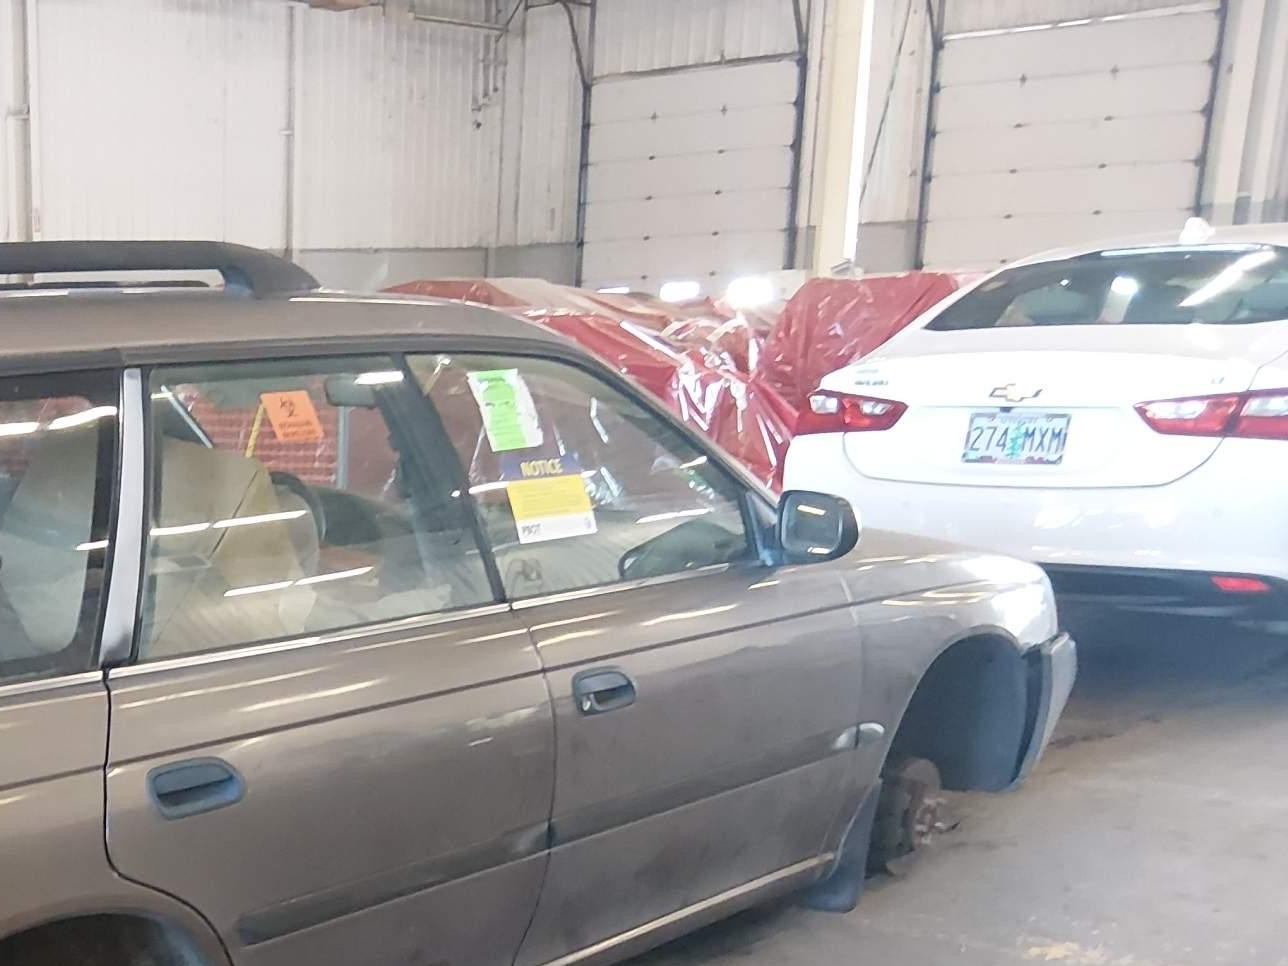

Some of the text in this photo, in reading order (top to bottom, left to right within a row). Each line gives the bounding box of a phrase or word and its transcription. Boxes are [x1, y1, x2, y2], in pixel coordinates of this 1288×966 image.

[969, 426, 1064, 453] 274 MXM
[520, 459, 563, 477] NOTICE
